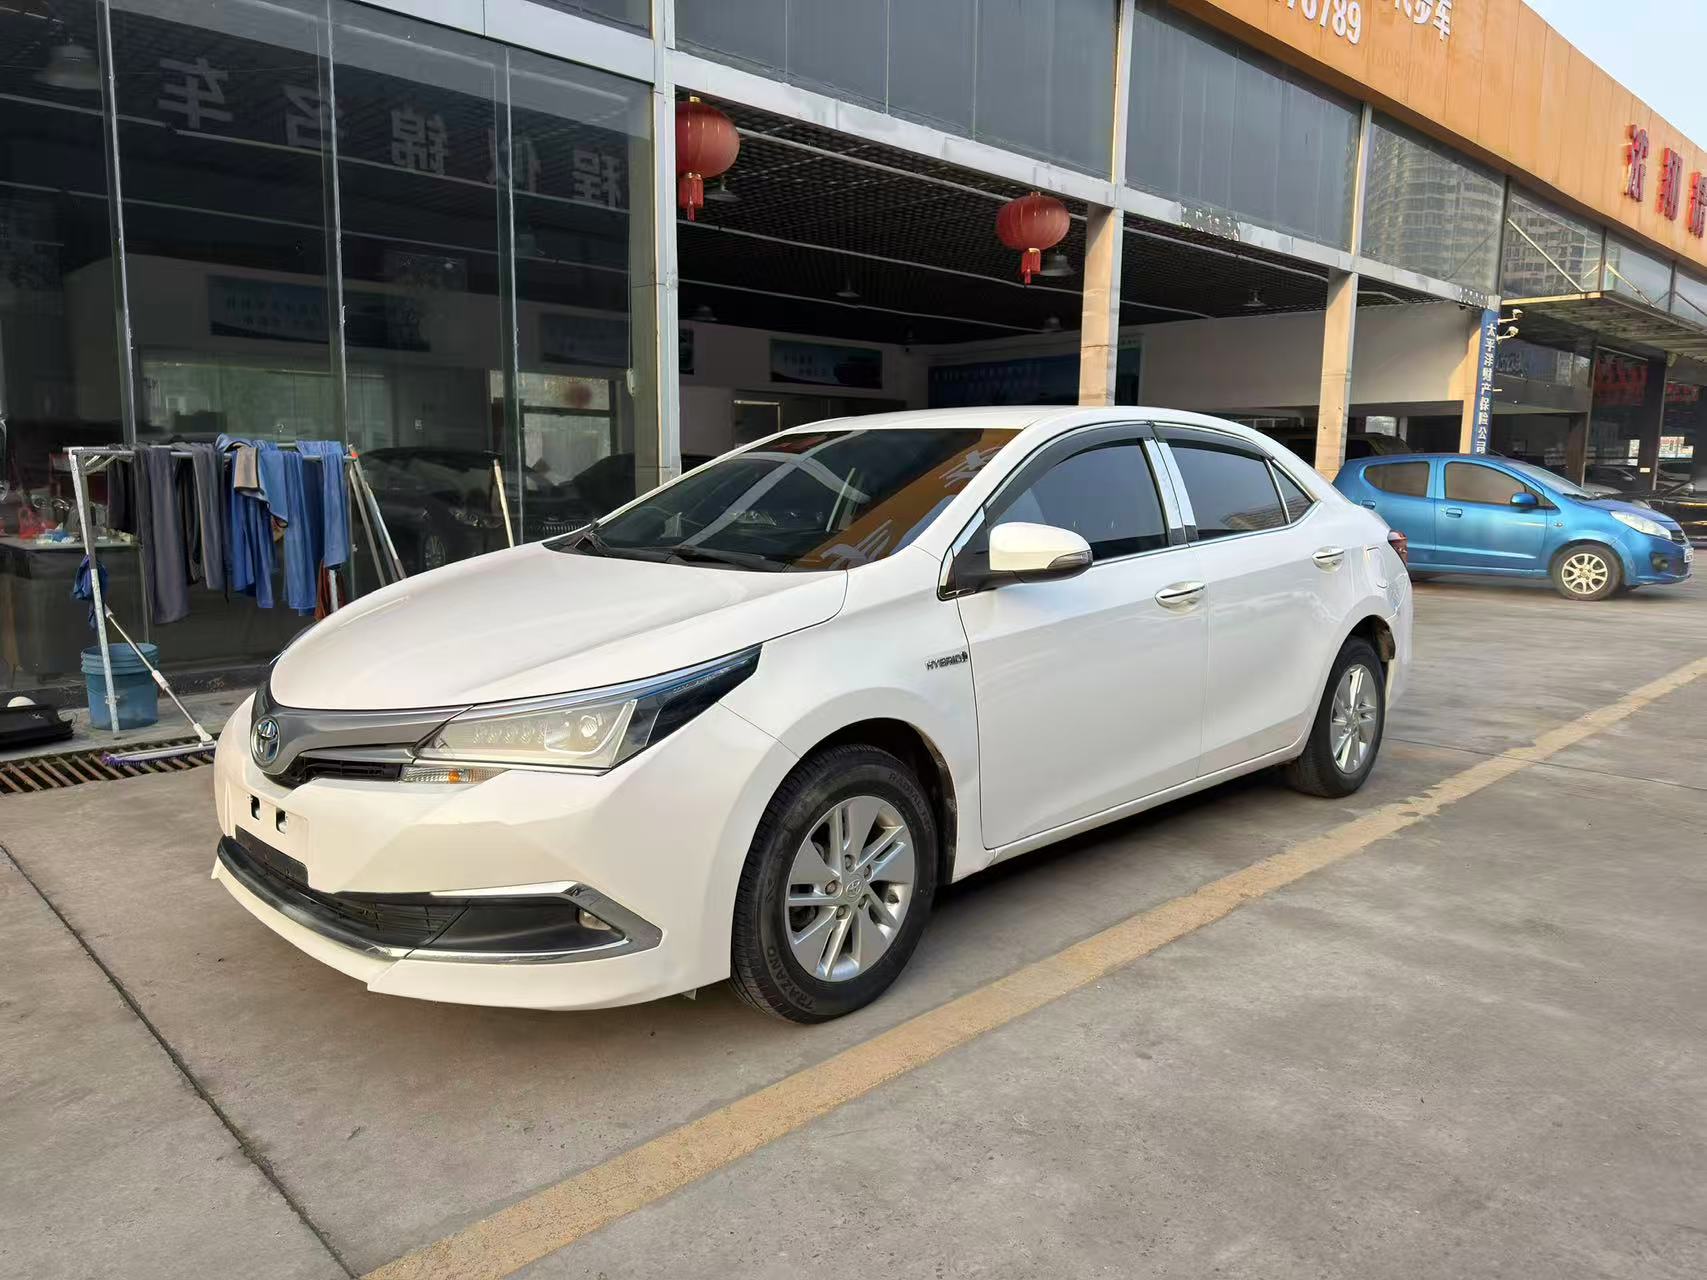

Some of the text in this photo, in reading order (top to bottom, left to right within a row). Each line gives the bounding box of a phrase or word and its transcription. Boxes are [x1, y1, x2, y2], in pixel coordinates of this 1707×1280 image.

[1284, 0, 1361, 45] 789
[1476, 323, 1497, 454] 太平洋财产保险公司
[926, 653, 963, 671] HYBRID
[767, 945, 815, 1010] TRAZANO
